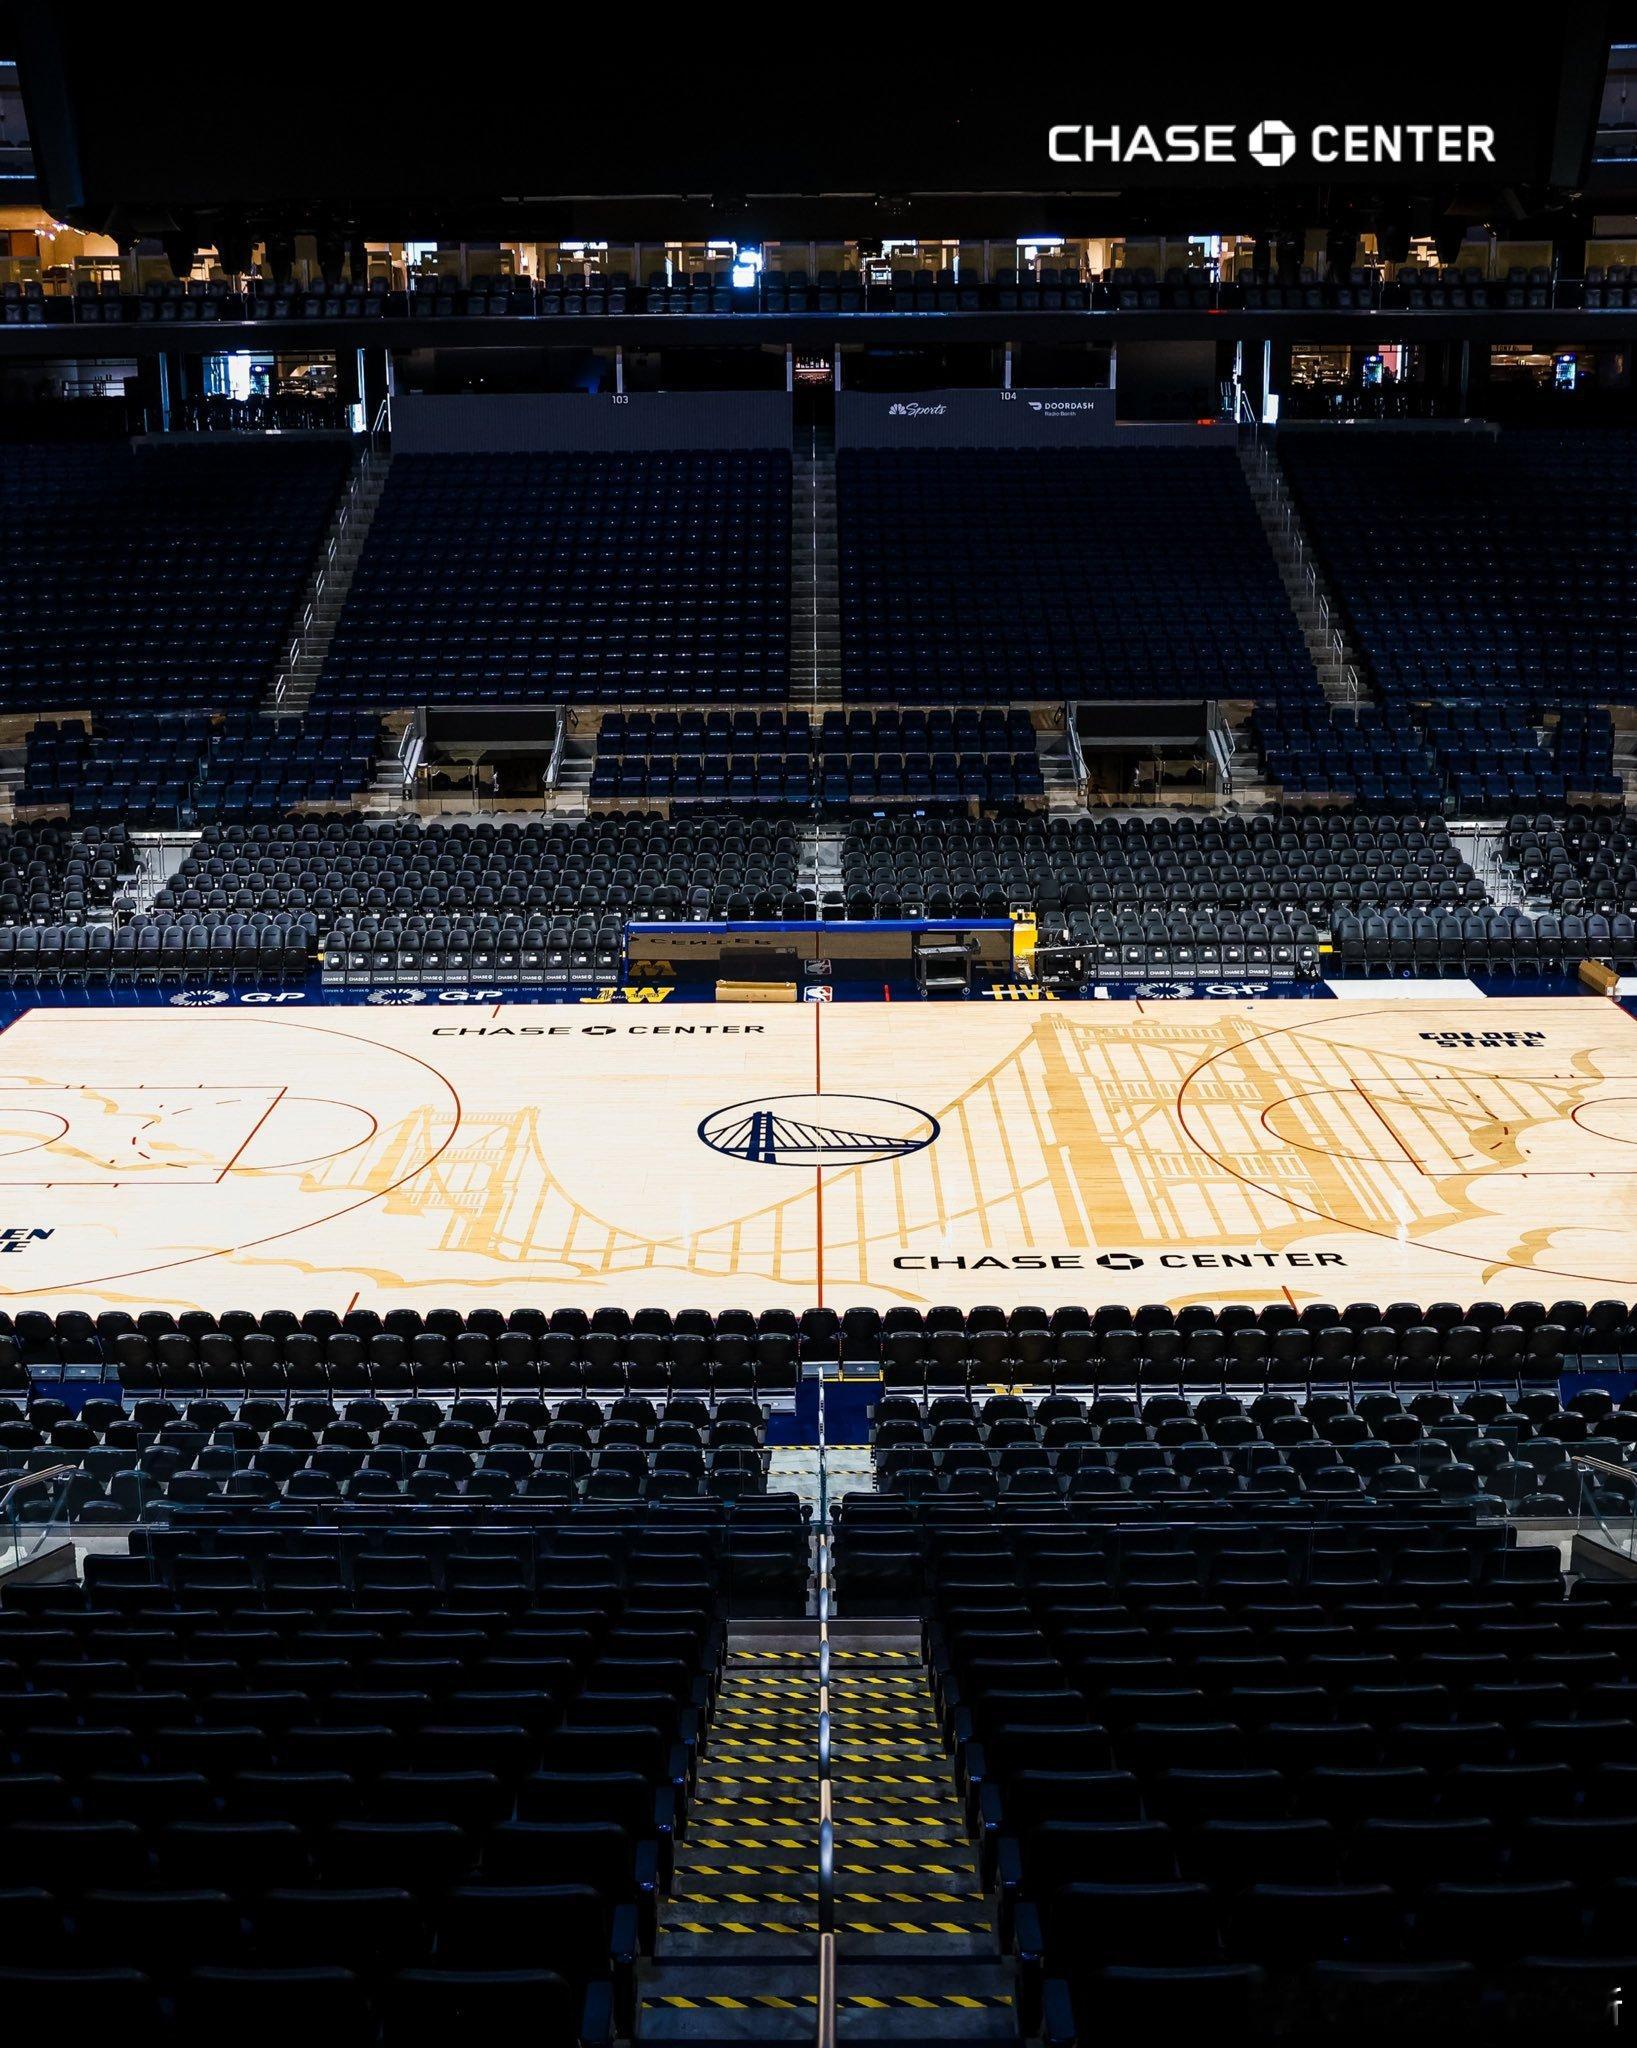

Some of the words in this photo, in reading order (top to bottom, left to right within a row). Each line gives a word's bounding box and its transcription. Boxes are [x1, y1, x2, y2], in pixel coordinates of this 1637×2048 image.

[611, 395, 629, 405] 103
[1000, 391, 1017, 401] 104
[906, 402, 947, 419] Sports
[1044, 402, 1094, 410] DOORDASH
[432, 1027, 571, 1036] CHASE
[629, 1026, 765, 1035] CENTER
[893, 1255, 1085, 1270] CHASE
[1160, 1252, 1348, 1269] CENTER
